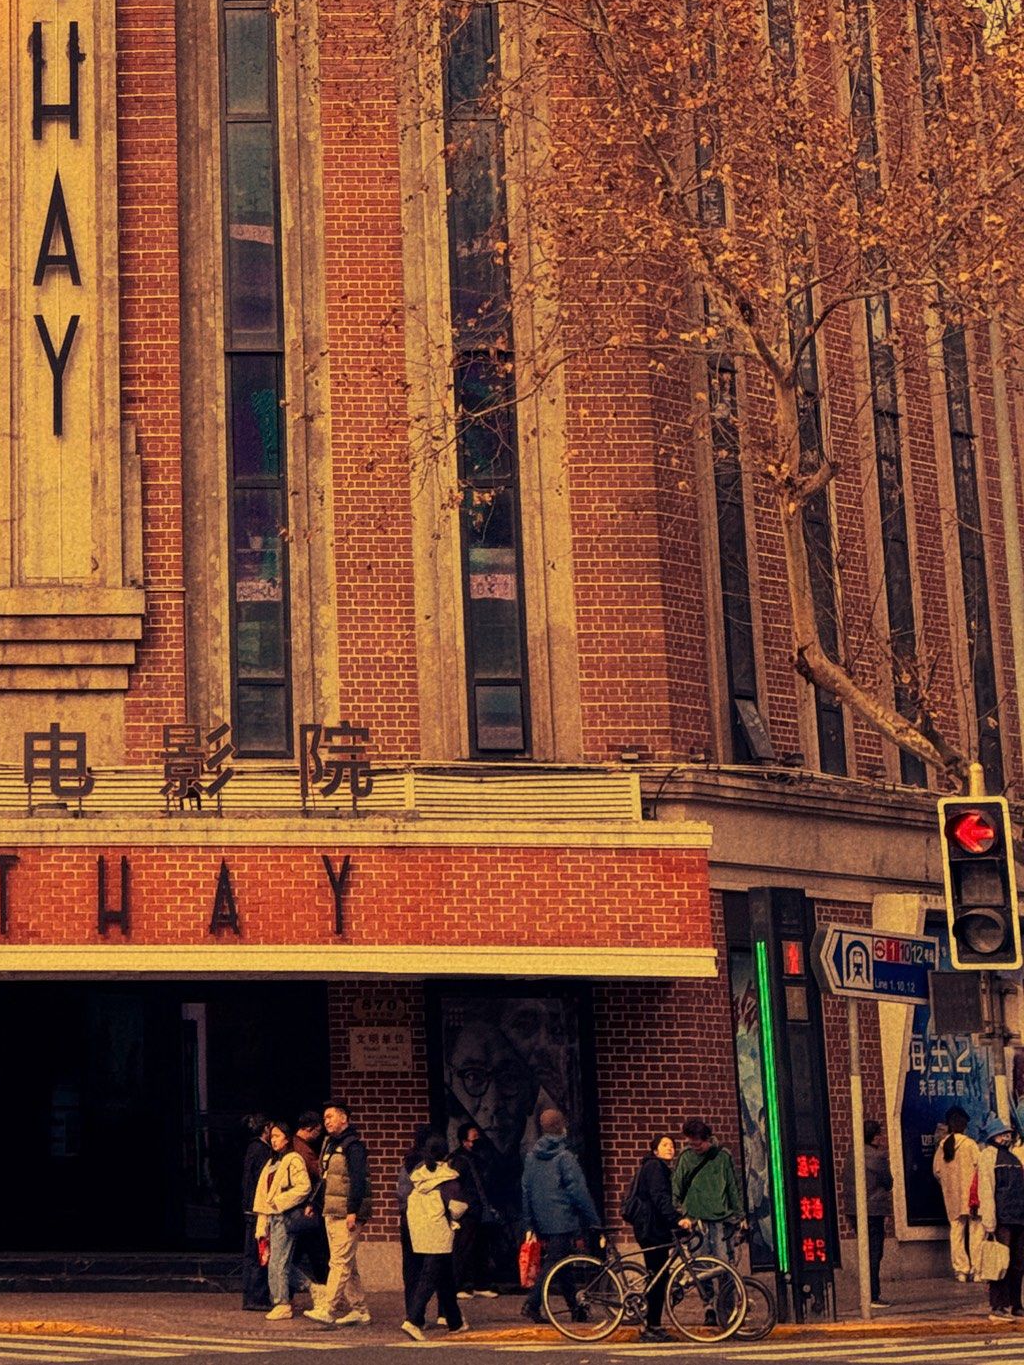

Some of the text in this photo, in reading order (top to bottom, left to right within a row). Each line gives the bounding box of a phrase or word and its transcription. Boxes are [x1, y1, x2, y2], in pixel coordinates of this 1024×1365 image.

[912, 945, 923, 964] 12
[874, 978, 888, 989] Line
[803, 1238, 826, 1261] 信号
